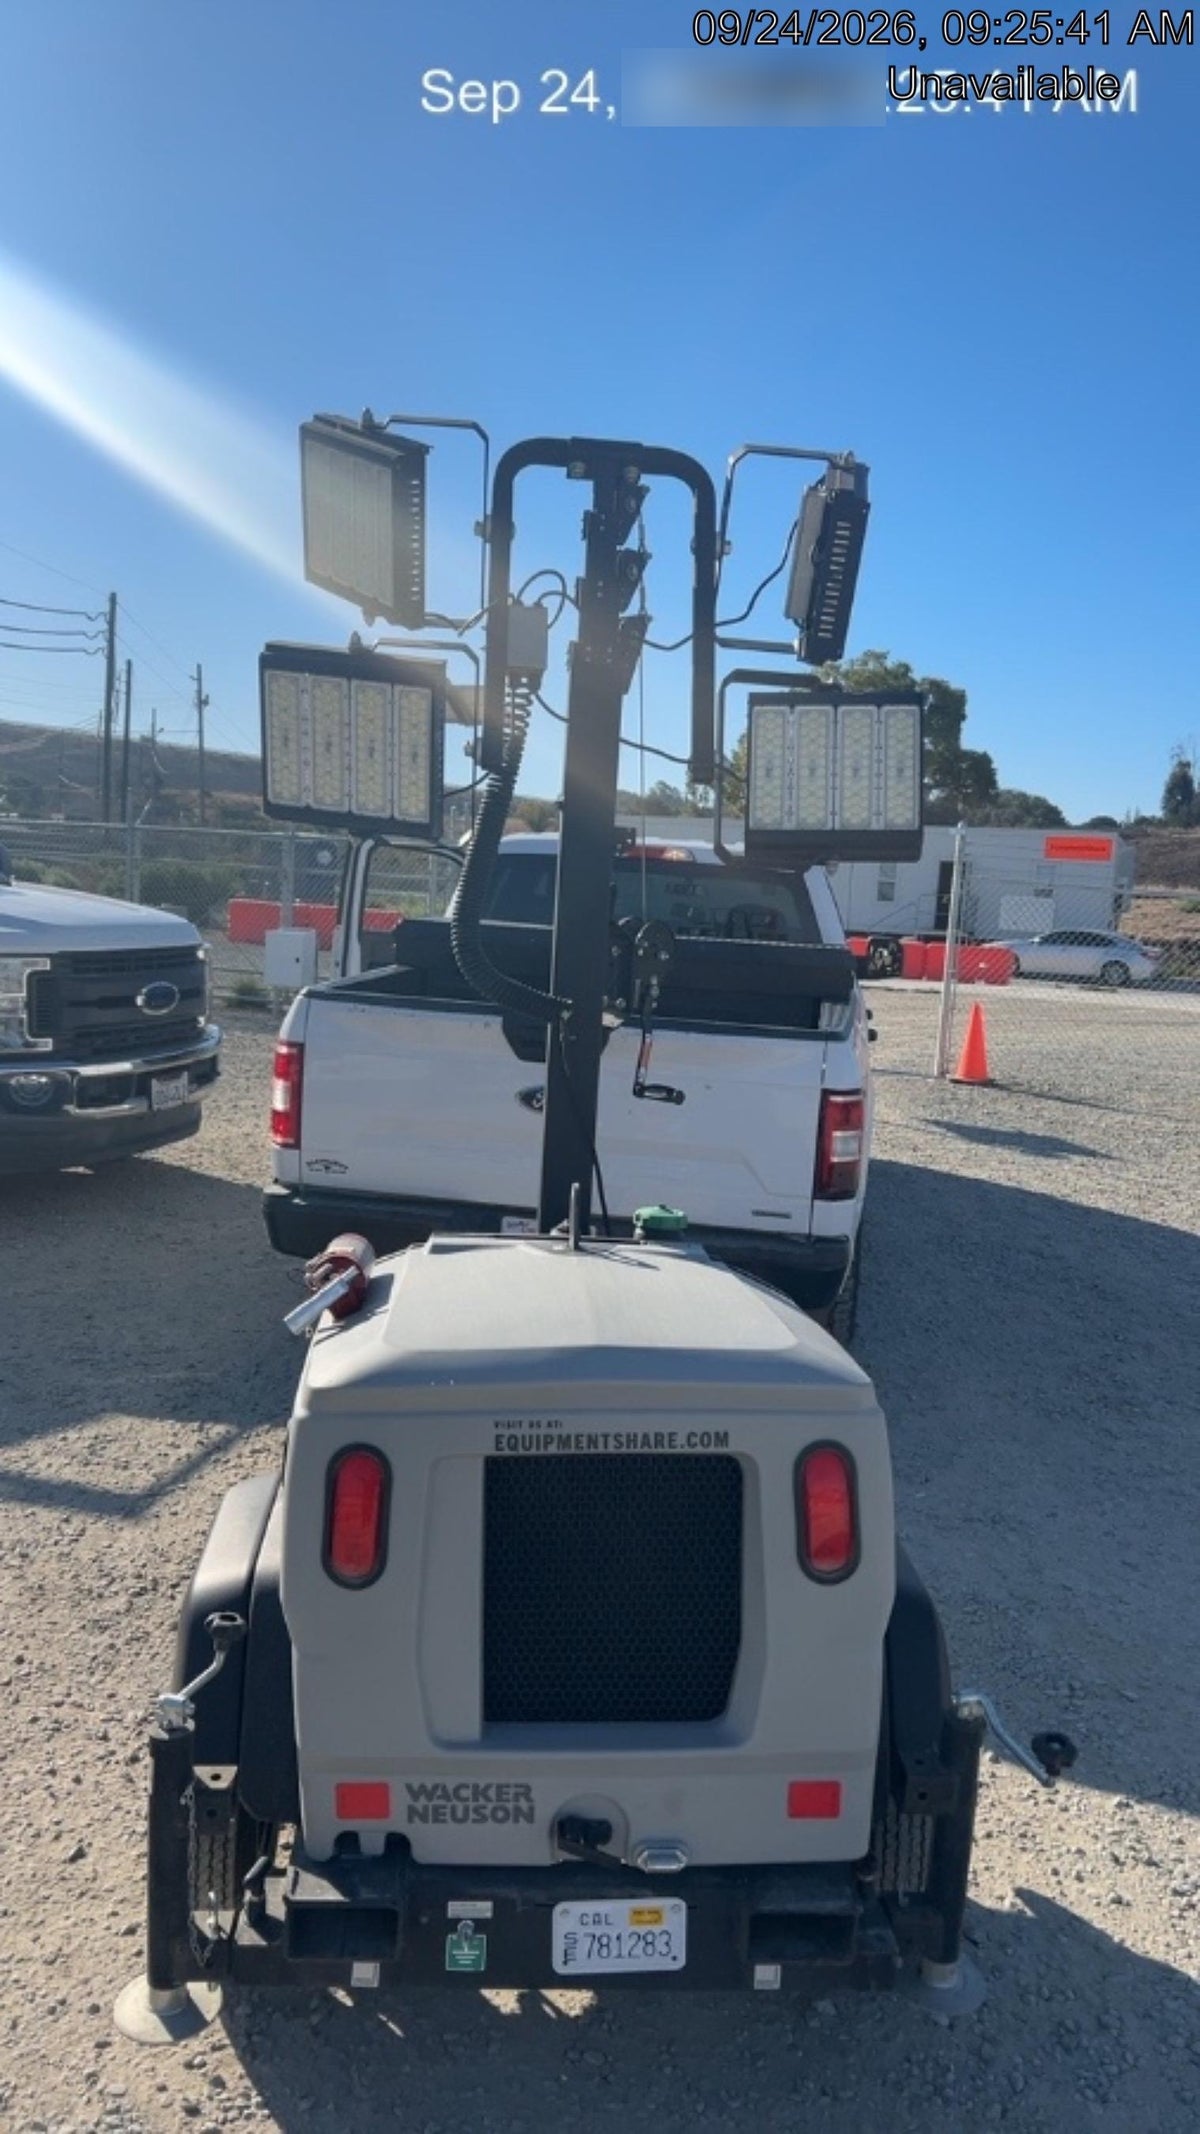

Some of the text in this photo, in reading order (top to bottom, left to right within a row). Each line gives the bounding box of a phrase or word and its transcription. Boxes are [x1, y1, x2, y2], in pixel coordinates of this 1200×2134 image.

[495, 1431, 730, 1452] EQUIPMENTSHARE.COM
[405, 1782, 534, 1801] WACKER
[406, 1804, 536, 1824] NEUSON
[580, 1912, 614, 1926] CAL
[583, 1930, 672, 1959] 781283
